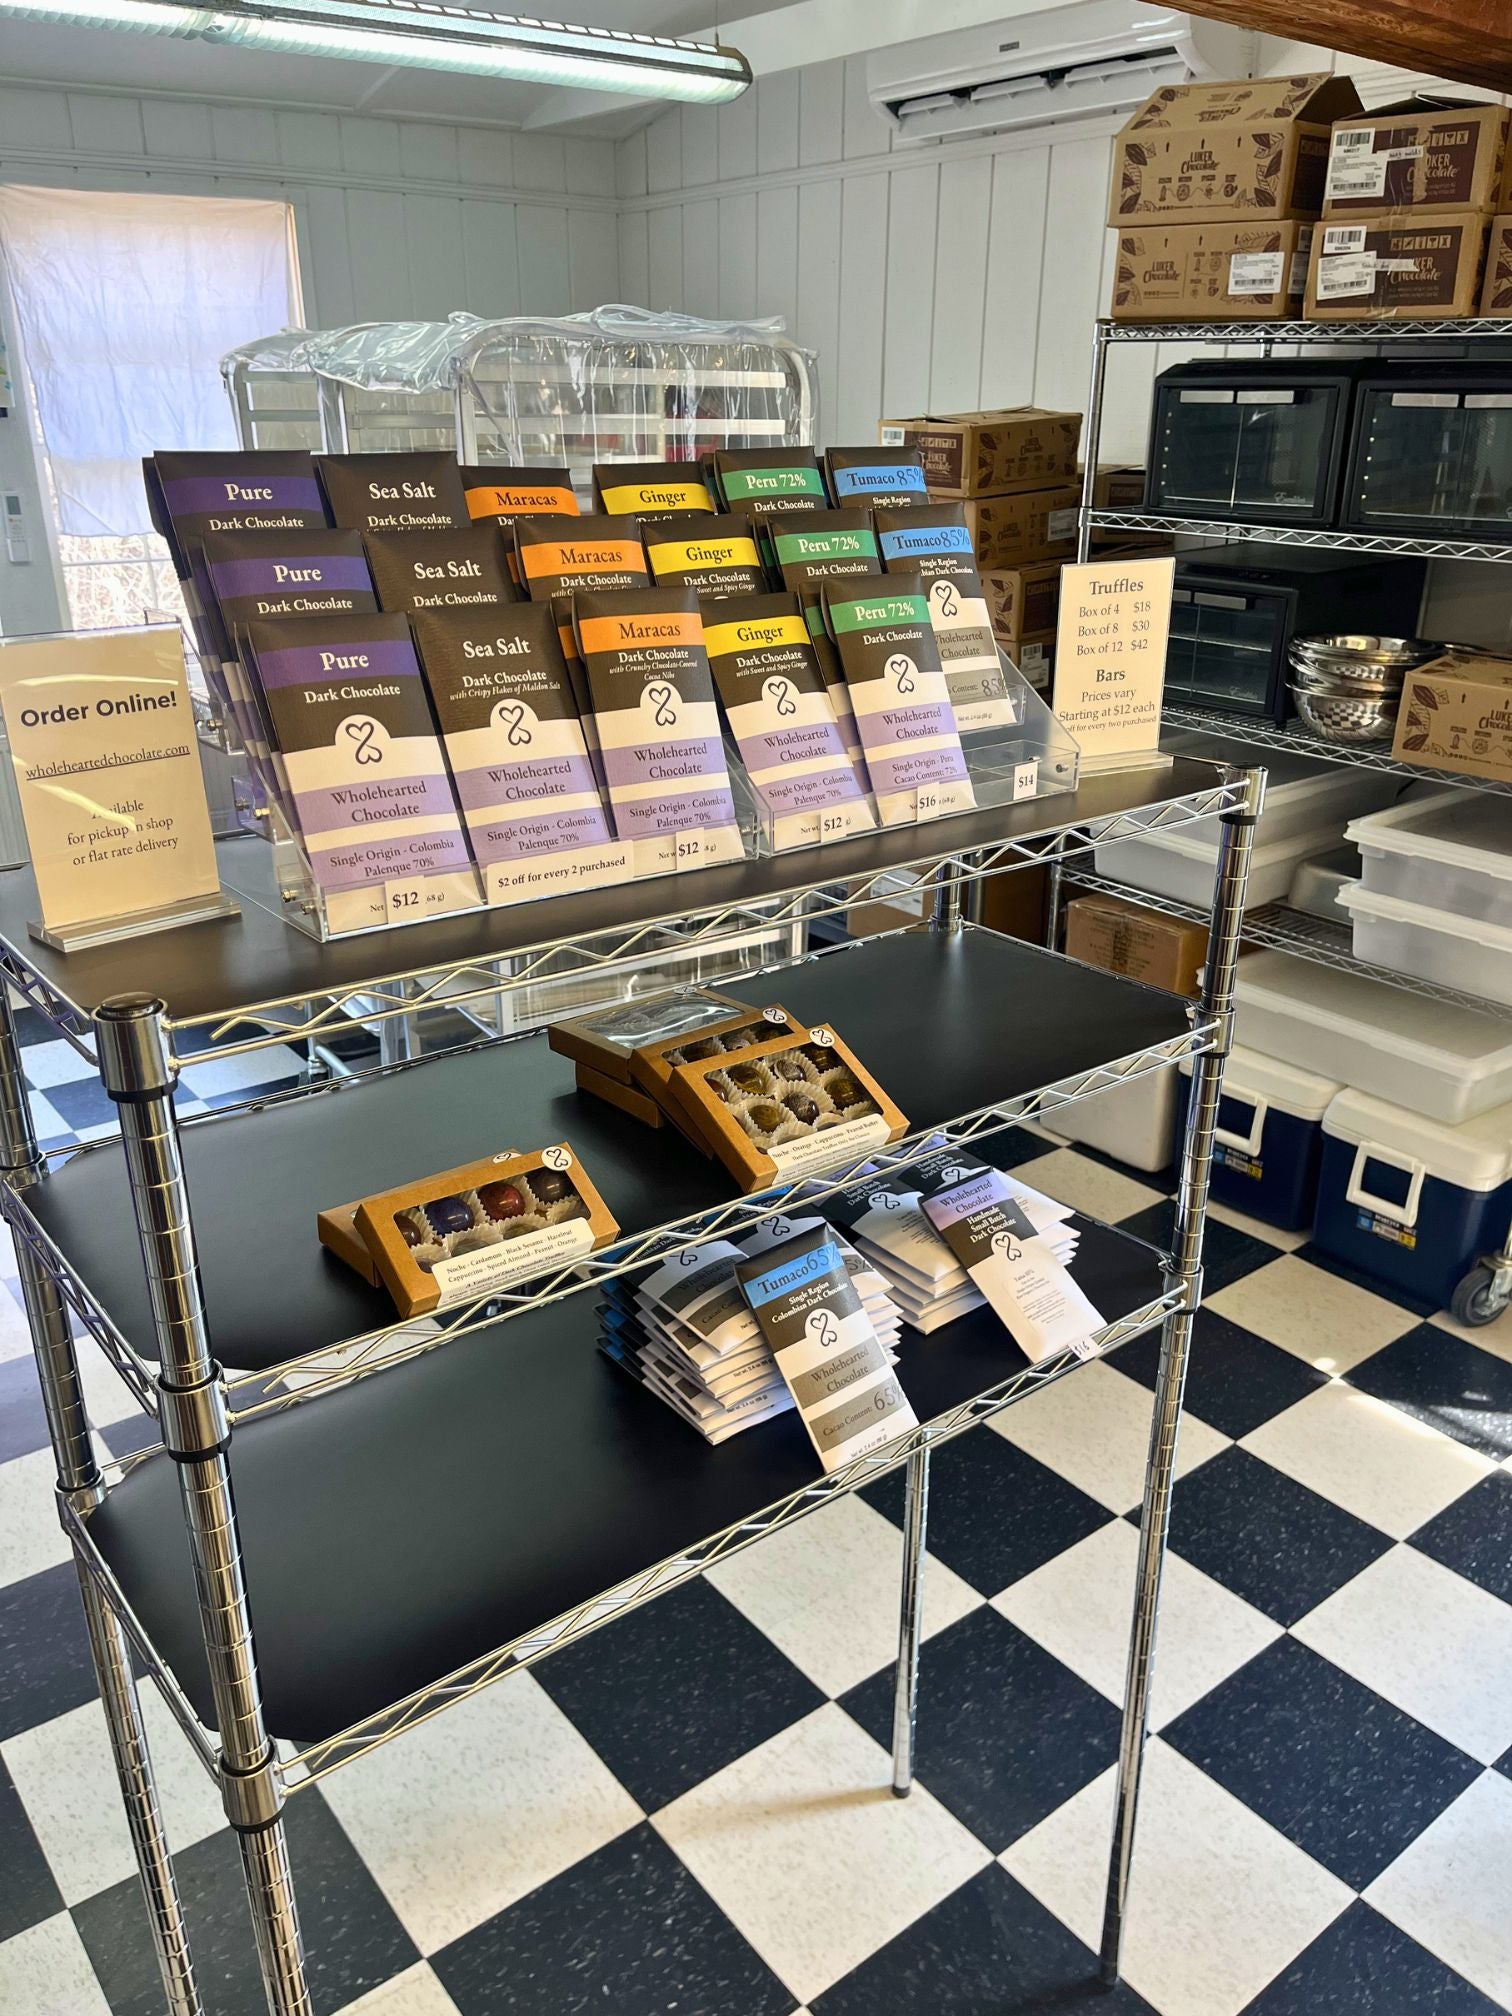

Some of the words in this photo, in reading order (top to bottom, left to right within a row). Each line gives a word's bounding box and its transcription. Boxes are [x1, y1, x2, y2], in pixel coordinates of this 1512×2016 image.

[1190, 151, 1213, 162] LUKER
[1181, 160, 1220, 174] Chocolate
[1152, 260, 1175, 272] LUKER
[1143, 270, 1181, 283] Chocolate
[745, 473, 778, 489] Peru
[779, 472, 807, 488] 72%
[847, 473, 895, 487] Tumaco
[896, 466, 925, 486] 85%
[225, 482, 273, 501] Pure
[369, 482, 400, 500] Sea
[404, 481, 436, 498] Salt
[496, 491, 558, 506] Maracas
[639, 489, 686, 507] Ginger
[753, 500, 777, 512] Dark
[778, 498, 815, 511] Chocolate
[209, 517, 243, 531] Dark
[245, 515, 304, 529] Chocolate
[367, 514, 397, 527] Dark
[399, 512, 452, 526] Chocolate
[559, 548, 622, 565] Maracas
[685, 547, 733, 564] Ginger
[273, 564, 322, 583] Pure
[414, 562, 445, 579] Sea
[449, 560, 482, 578] Salt
[1090, 579, 1144, 596] Truffles
[854, 605, 887, 621] Peru
[887, 602, 915, 617] 72%
[1079, 606, 1098, 618] Box
[1101, 604, 1111, 616] of
[1113, 604, 1120, 615] 4
[1133, 601, 1151, 614] $18
[617, 622, 681, 640] Maracas
[736, 626, 784, 644] Ginger
[863, 633, 885, 645] Dark
[886, 630, 923, 642] Chocolate
[1078, 625, 1097, 637] Box
[1099, 623, 1111, 635] of
[1112, 622, 1119, 633] 8
[1132, 620, 1150, 632] $30
[463, 640, 494, 659] Sea
[496, 636, 532, 656] Salt
[618, 651, 644, 663] Dark
[646, 648, 689, 661] Chocolate
[1076, 644, 1095, 656] Box
[1098, 642, 1109, 654] of
[1112, 641, 1123, 652] 12
[1130, 638, 1148, 651] $42
[319, 651, 369, 671] Pure
[735, 656, 761, 668] Dark
[762, 651, 803, 666] Chocolate
[462, 674, 492, 688] Dark
[494, 670, 547, 684] Chocolate
[1096, 669, 1126, 683] Bars
[303, 689, 339, 704] Dark
[341, 683, 401, 700] Chocolate
[449, 690, 468, 702] with
[468, 687, 491, 700] Crispy
[492, 684, 513, 696] Flakes
[512, 683, 522, 695] of
[522, 682, 548, 692] Maldon
[1081, 690, 1112, 703] Prices
[1113, 687, 1137, 701] vary
[20, 703, 89, 727] Order
[96, 690, 178, 717] Online!
[883, 707, 942, 725] Wholehearted
[1059, 707, 1099, 723] Starting
[1101, 706, 1113, 717] at
[1113, 703, 1131, 717] $12
[1132, 701, 1155, 714] each
[896, 724, 939, 740] Chocolate
[1076, 722, 1087, 731] for
[1087, 721, 1107, 731] every
[1108, 718, 1121, 728] two
[1122, 715, 1157, 728] purchased
[763, 729, 830, 748] Wholehearted
[25, 743, 191, 780] wholeheartedchocolate.com
[633, 743, 708, 763] Wholehearted
[779, 745, 827, 762] Chocolate
[487, 761, 572, 784] Wholehearted
[649, 762, 703, 779] Chocolate
[891, 761, 912, 773] Single
[913, 757, 935, 770] Origin
[939, 754, 954, 764] Peru
[894, 775, 916, 785] Cacao
[917, 770, 944, 781] Content:
[1018, 775, 1034, 788] $14
[331, 781, 427, 807] Wholehearted
[505, 781, 567, 801] Chocolate
[919, 795, 936, 809] $16
[351, 804, 420, 823] Chocolate
[67, 831, 85, 846] for
[88, 825, 129, 846] pickup
[146, 816, 174, 835] shop
[487, 827, 517, 843] Single
[519, 823, 550, 840] Origin
[556, 815, 597, 832] Colombia
[823, 816, 843, 832] $12
[72, 855, 86, 866] or
[89, 848, 109, 863] flat
[111, 845, 134, 859] rate
[135, 836, 179, 854] delivery
[518, 836, 559, 852] Palenque
[560, 832, 580, 845] 70%
[678, 842, 700, 857] $12
[329, 852, 364, 869] Single
[365, 847, 401, 865] Origin
[409, 839, 455, 856] Colombia
[364, 861, 412, 879] Palenque
[413, 856, 435, 870] 70%
[498, 875, 510, 888] $2
[511, 873, 526, 886] off
[527, 870, 541, 883] for
[542, 868, 569, 883] every
[571, 864, 578, 875] 2
[579, 856, 626, 877] purchased
[392, 891, 420, 910] $12
[939, 1180, 993, 1208] Wholehearted
[955, 1193, 994, 1215] Chocolate
[966, 1206, 1001, 1225] Handmade
[970, 1219, 988, 1233] Small
[988, 1212, 1007, 1227] Batch
[969, 1230, 988, 1244] Dark
[987, 1217, 1017, 1237] Chocolate
[446, 1264, 467, 1275] Noche
[470, 1252, 502, 1266] Cardamom
[505, 1245, 521, 1255] Black
[522, 1238, 544, 1249] Sesame
[547, 1229, 573, 1242] Hazelnut
[448, 1268, 484, 1283] Cappuccino
[487, 1260, 507, 1271] Spiced
[508, 1251, 531, 1264] Almond
[534, 1244, 554, 1255] Peanut
[557, 1237, 578, 1248] Orange
[757, 1265, 809, 1296] Tumaco
[806, 1242, 841, 1270] 65%
[788, 1289, 809, 1305] Single
[807, 1279, 830, 1298] Region
[771, 1302, 807, 1325] Colombian
[806, 1293, 824, 1310] Dark
[820, 1281, 849, 1303] Chocolate
[811, 1346, 870, 1383] Wholehearted
[826, 1364, 870, 1394] Chocolate
[822, 1419, 845, 1439] Cacao
[843, 1404, 874, 1427] Content:
[873, 1381, 908, 1411] 65%
